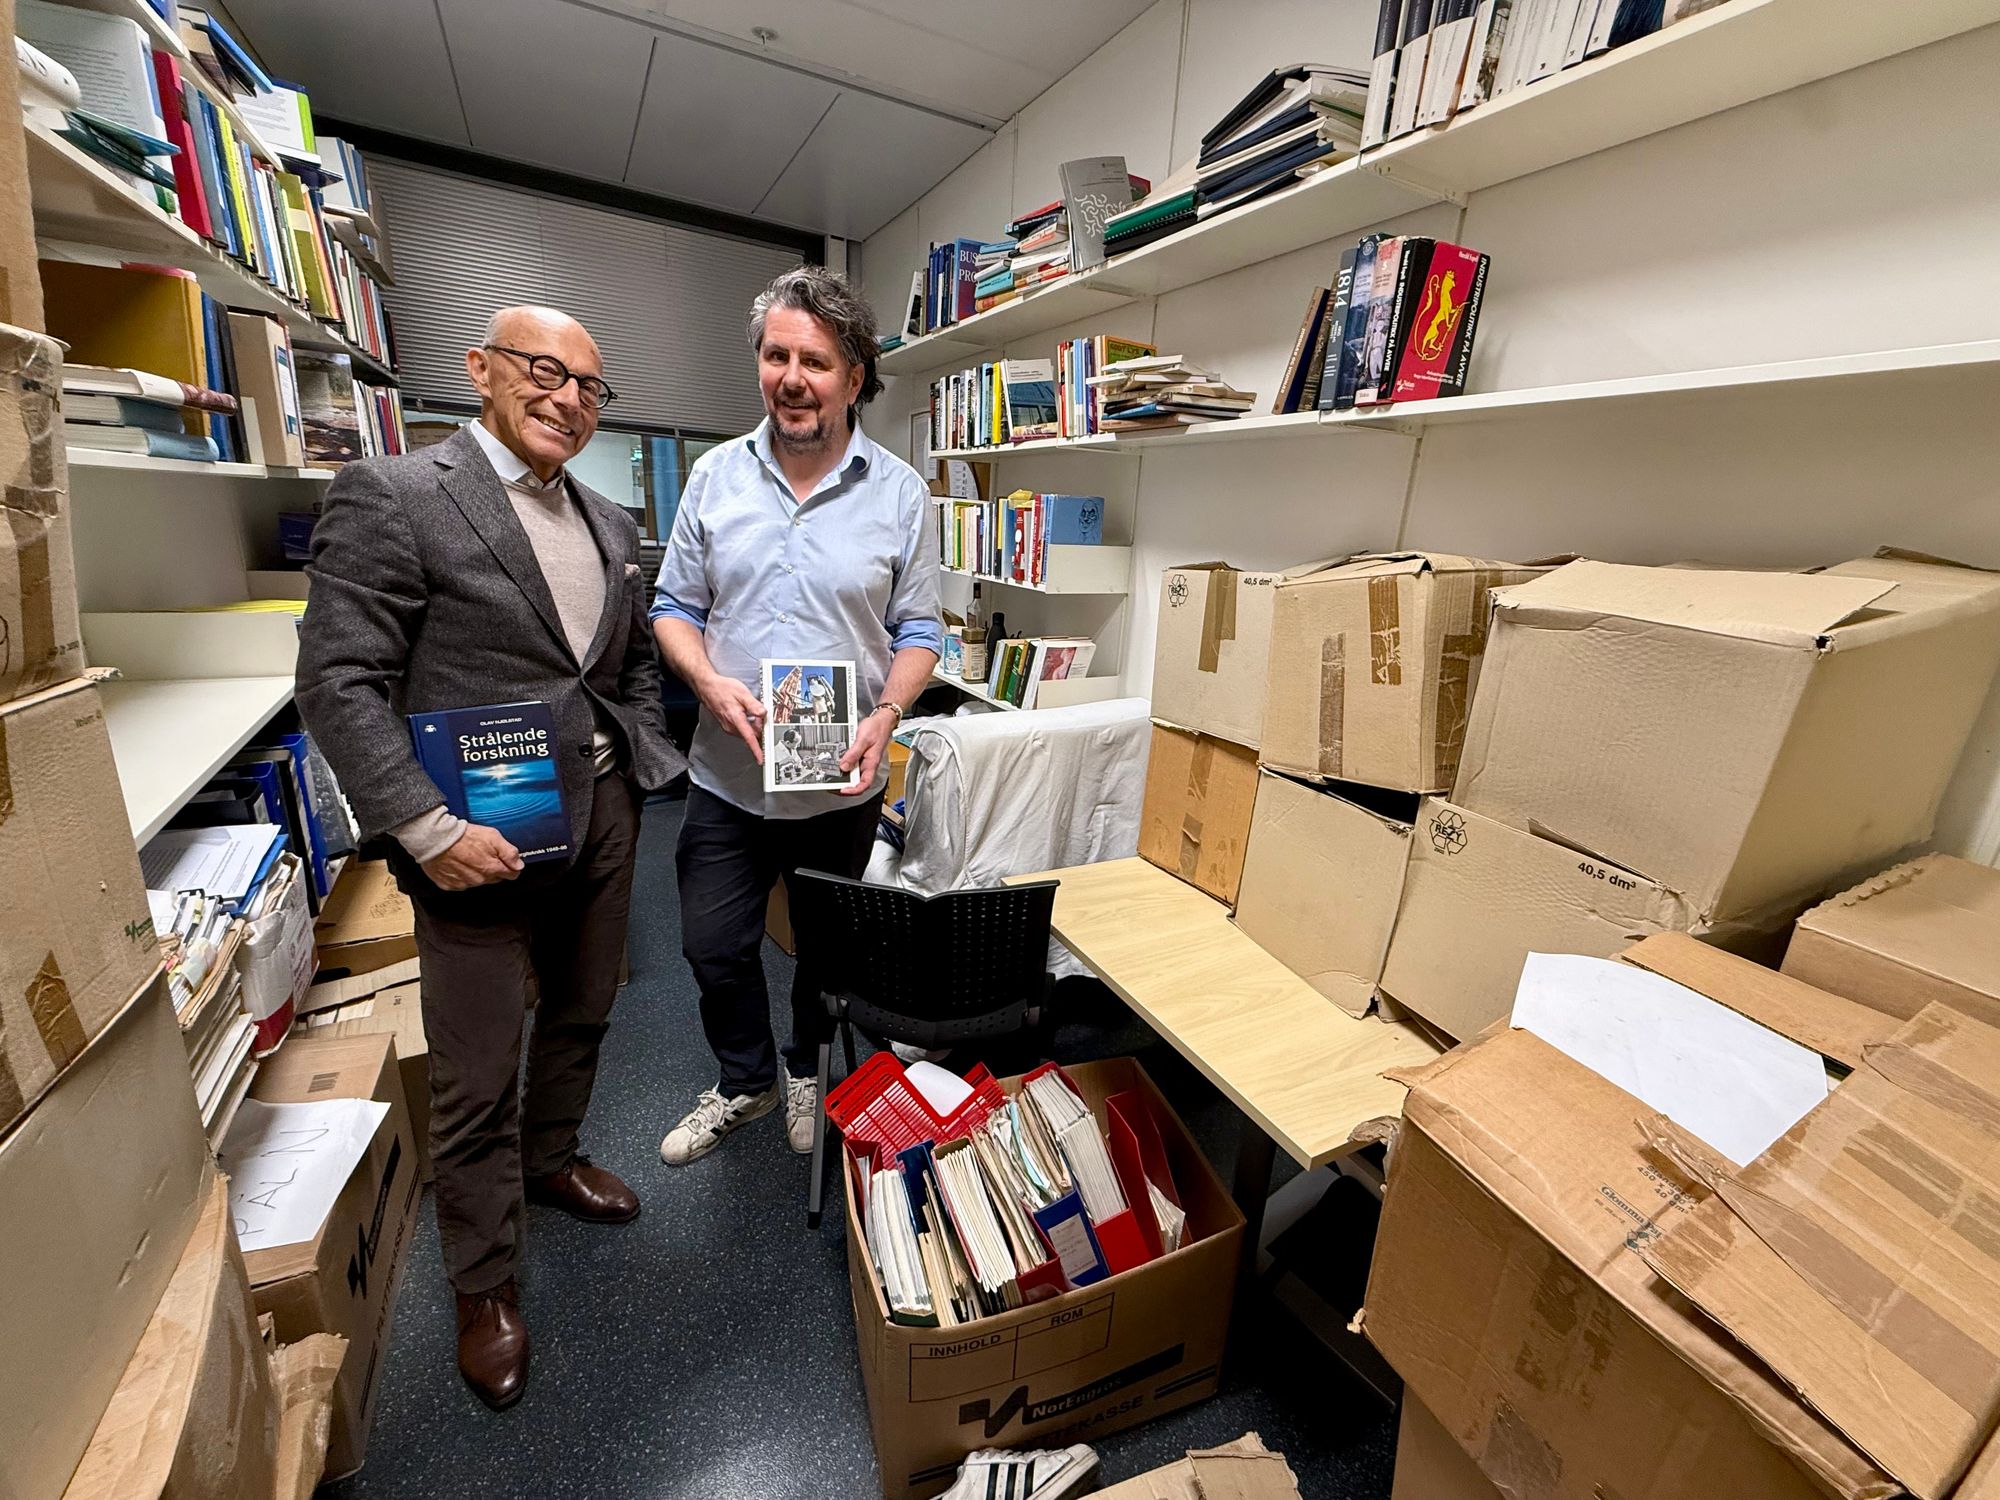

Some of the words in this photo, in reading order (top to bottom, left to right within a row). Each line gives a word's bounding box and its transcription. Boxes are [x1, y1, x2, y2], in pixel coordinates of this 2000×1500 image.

[1336, 266, 1352, 309] 1814
[1465, 257, 1487, 339] INDUSTRIPOLITIKK
[1390, 282, 1405, 338] INDUSTRIPOLITIKK
[1387, 339, 1394, 348] PÅ
[1461, 340, 1471, 353] PÅ
[1384, 349, 1393, 371] AVVEIE
[1455, 354, 1467, 387] AVVEIE
[1244, 578, 1258, 586] 40,5
[458, 728, 548, 749] Strålende
[463, 742, 549, 762] forskning
[1435, 824, 1462, 843] REZY
[1578, 862, 1606, 880] 40,5
[1609, 874, 1636, 891] dm³
[1637, 1166, 1656, 1181] 450
[1668, 1188, 1686, 1205] 300
[1654, 1188, 1668, 1198] 40
[1602, 1186, 1644, 1226] Glomma
[930, 1334, 1001, 1357] INNHOLD
[1050, 1308, 1084, 1326] ROM
